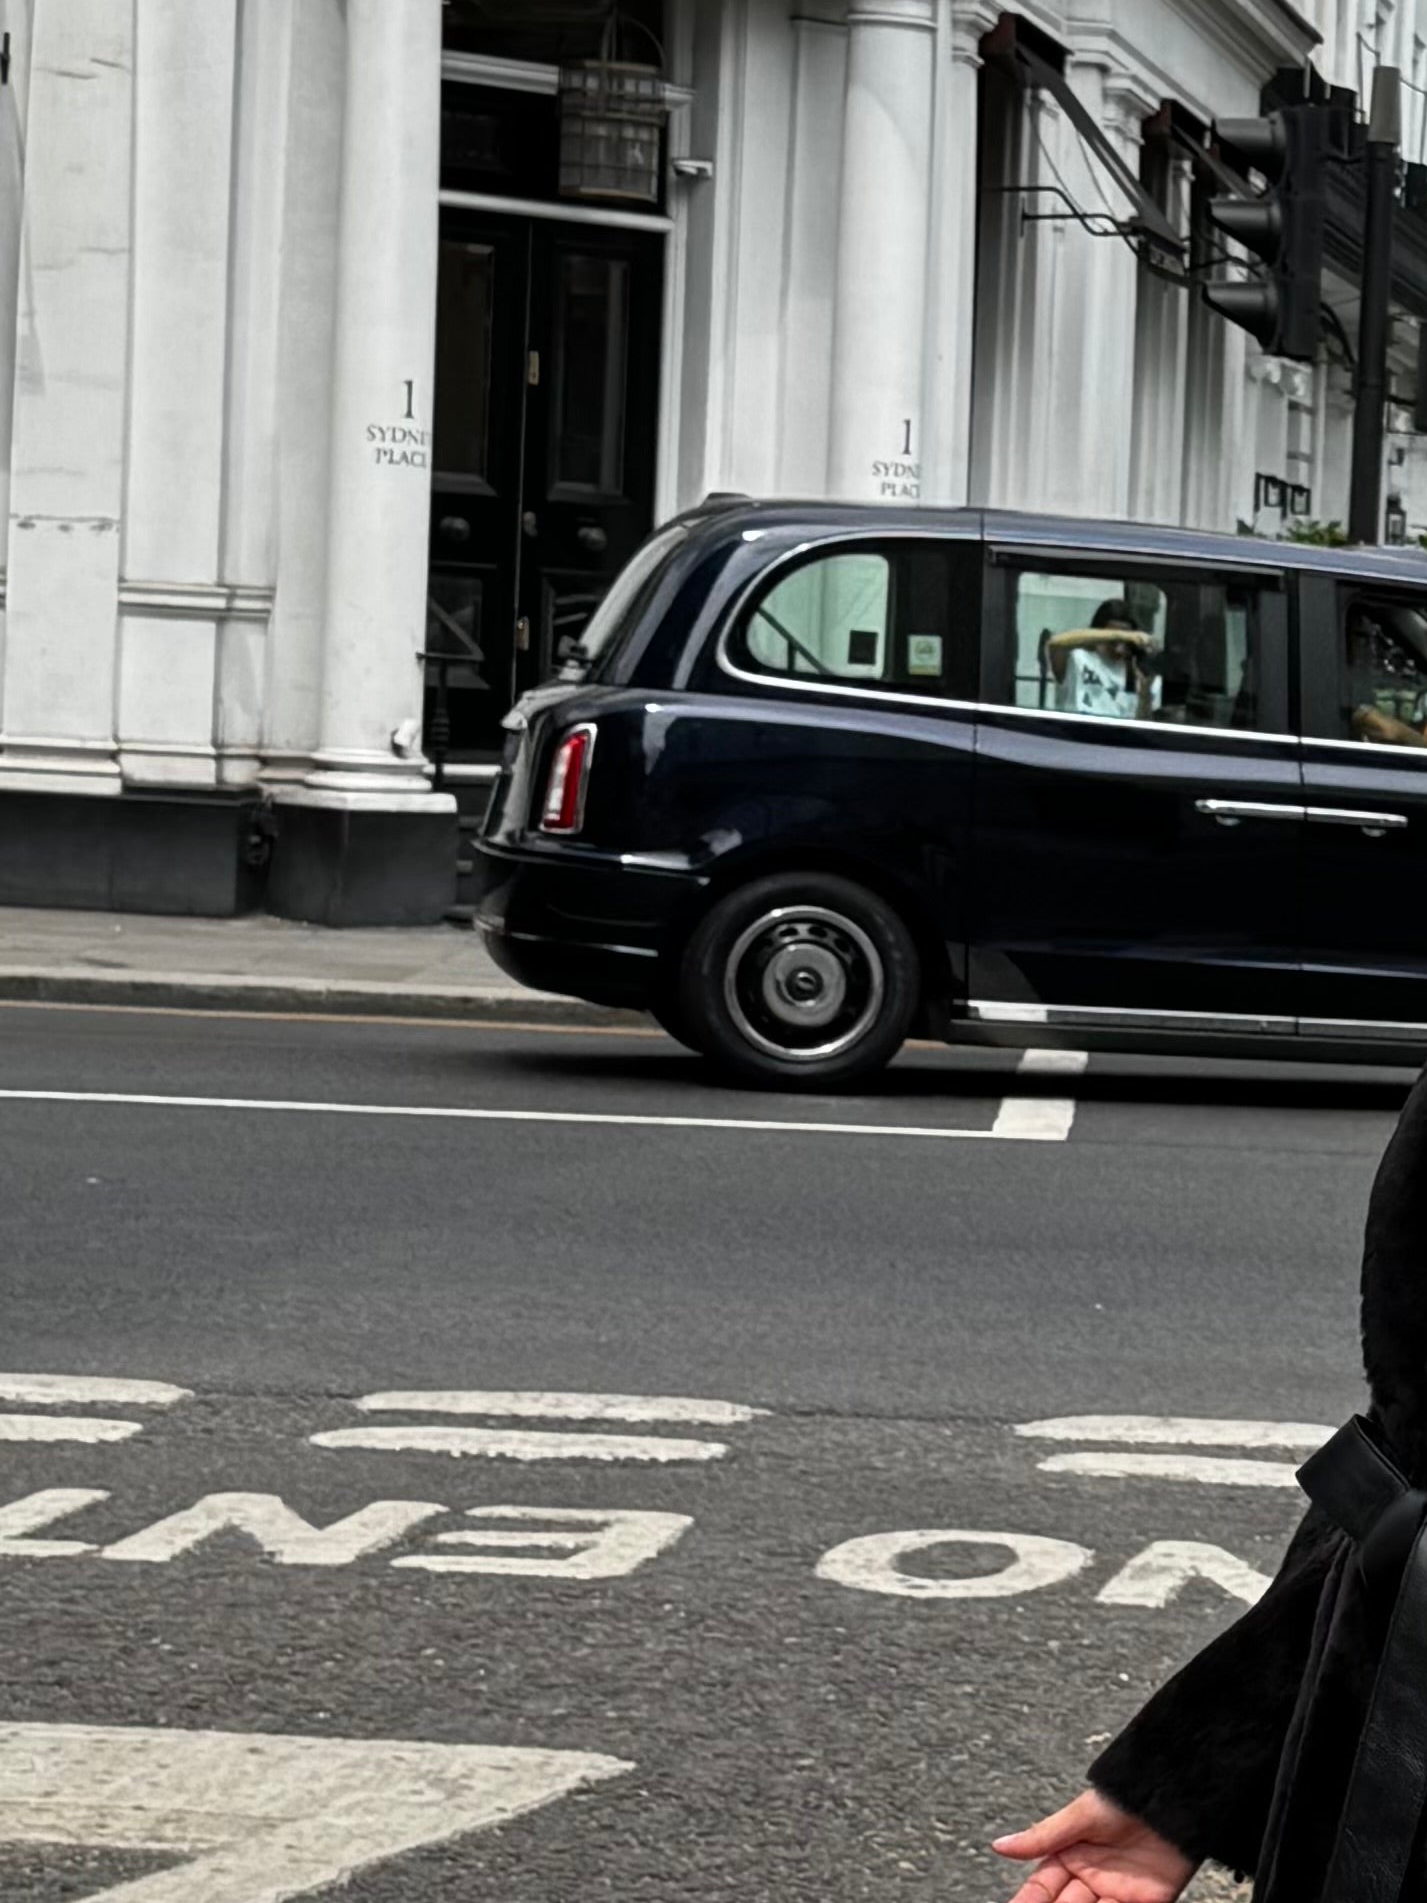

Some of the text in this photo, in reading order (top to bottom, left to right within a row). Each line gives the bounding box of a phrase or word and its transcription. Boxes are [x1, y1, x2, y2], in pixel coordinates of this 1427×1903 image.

[401, 379, 415, 419] 1
[902, 418, 911, 456] 1
[0, 1487, 695, 1580] ENT
